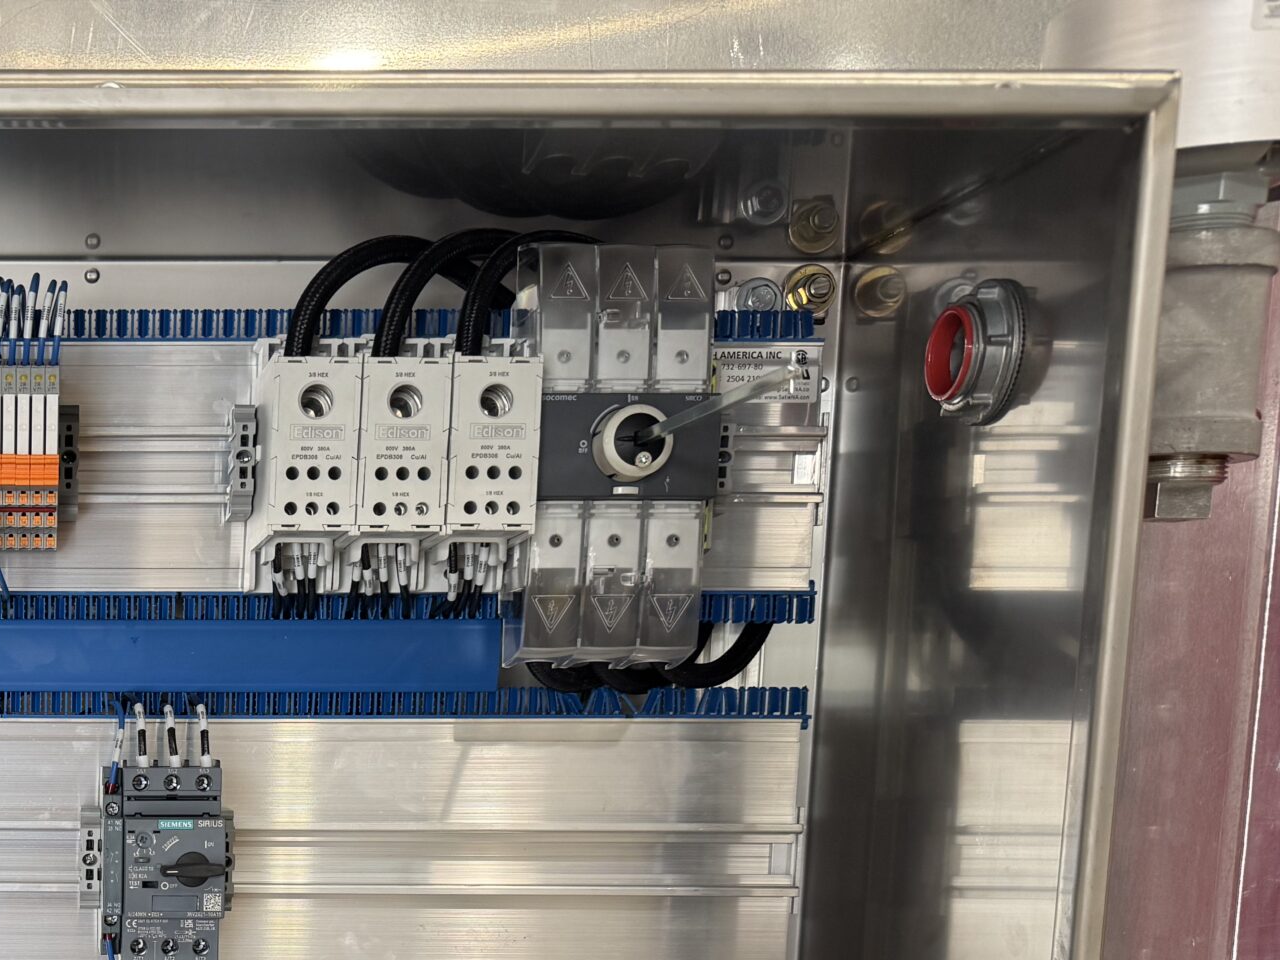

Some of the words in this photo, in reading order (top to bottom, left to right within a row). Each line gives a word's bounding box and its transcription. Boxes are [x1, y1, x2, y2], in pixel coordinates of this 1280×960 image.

[720, 351, 763, 360] AMERICA
[765, 351, 782, 360] INC
[726, 375, 745, 383] 2504
[295, 426, 342, 439] Edison
[379, 426, 427, 439] Edison
[475, 425, 522, 438] Edison
